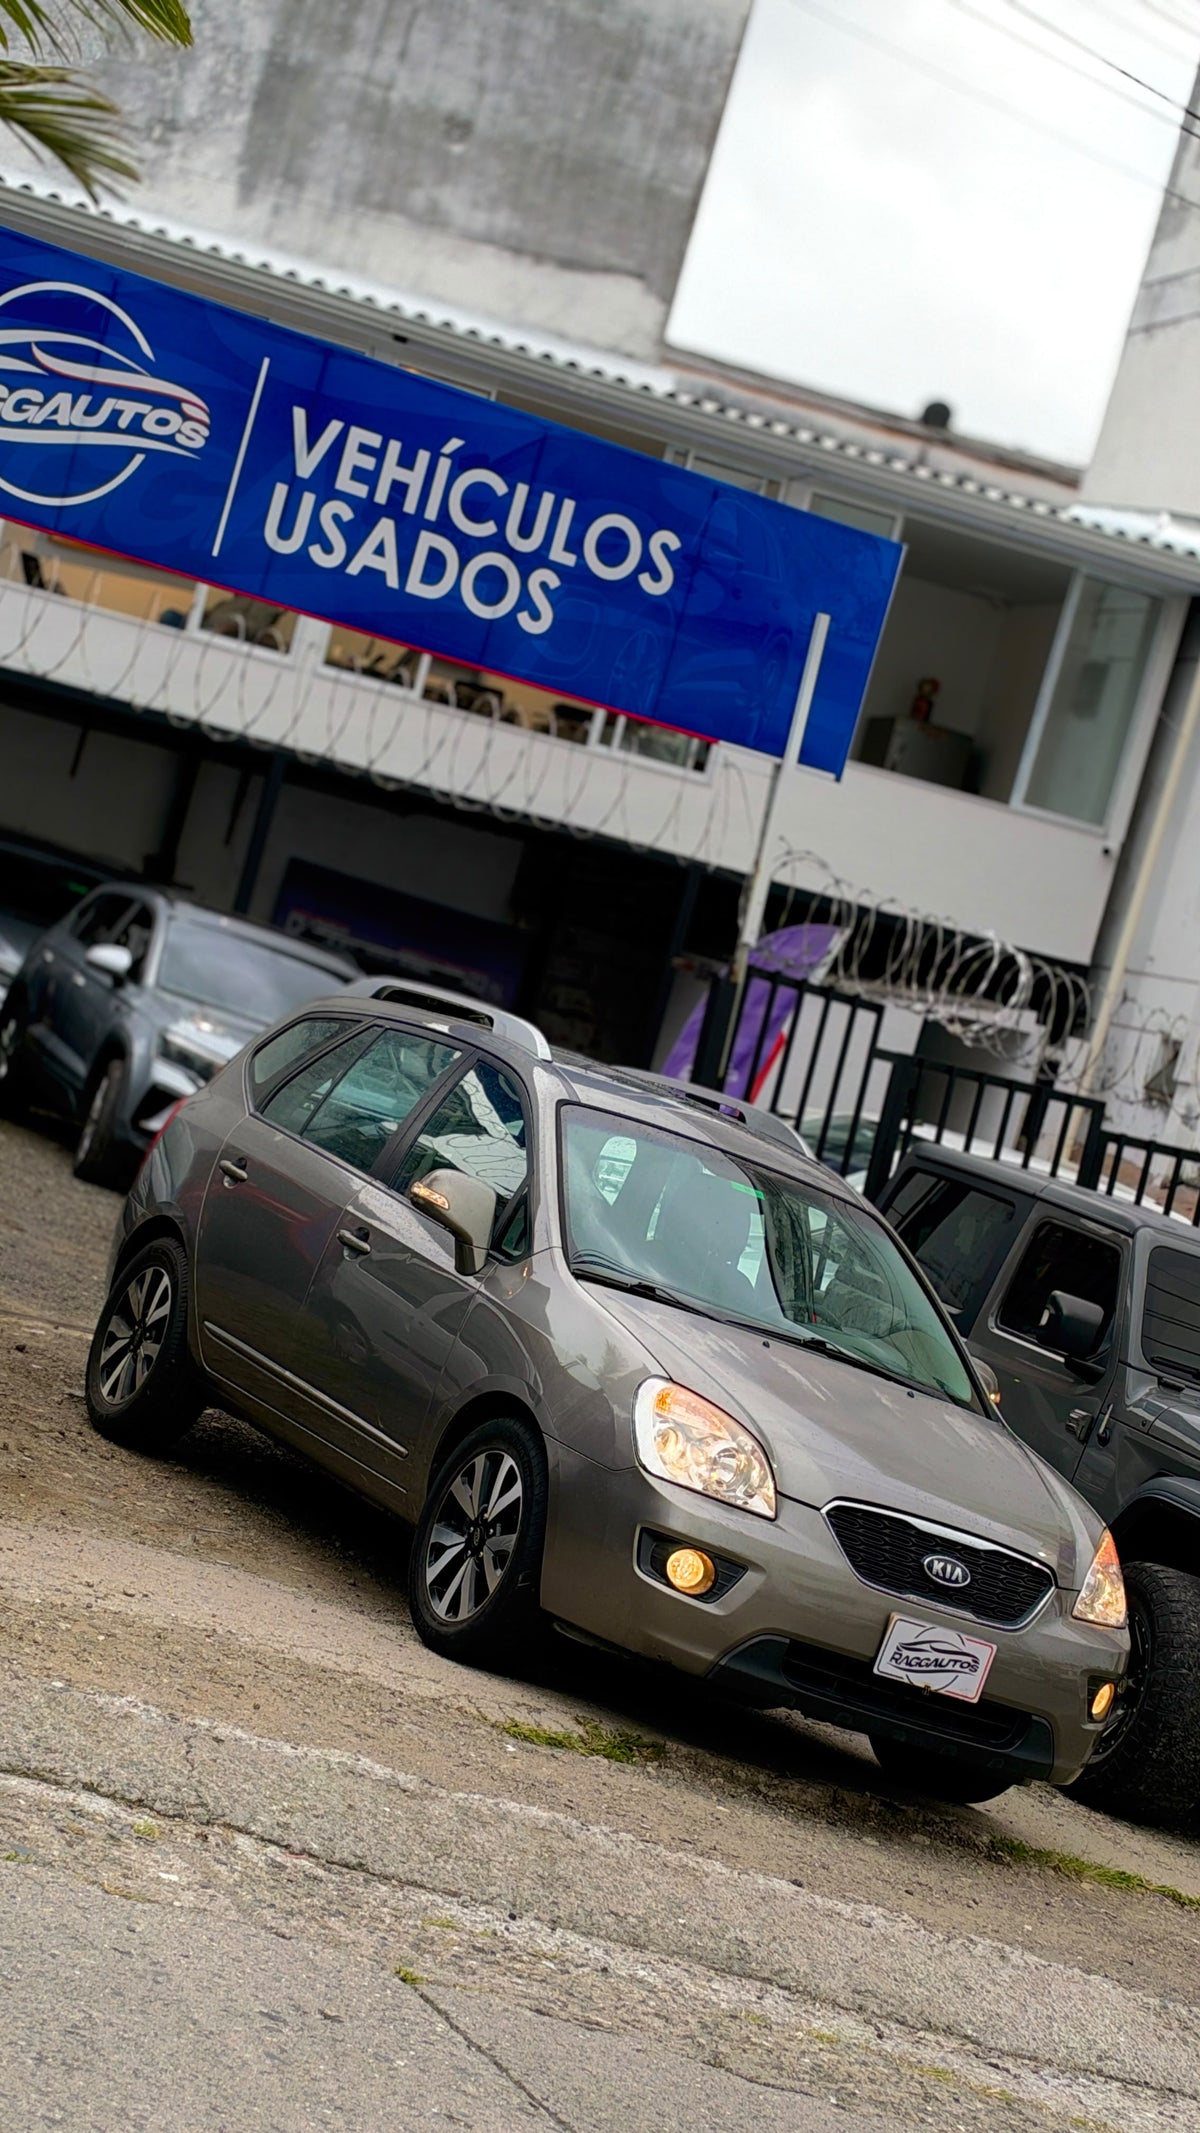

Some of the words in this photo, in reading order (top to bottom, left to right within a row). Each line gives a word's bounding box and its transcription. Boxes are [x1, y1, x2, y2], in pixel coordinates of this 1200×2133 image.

[0, 384, 210, 449] GAUTOS
[293, 405, 682, 596] VEHÍCULOS
[264, 482, 562, 635] USADOS
[932, 1559, 963, 1583] KIA
[889, 1651, 980, 1673] RAGGAUTOS
